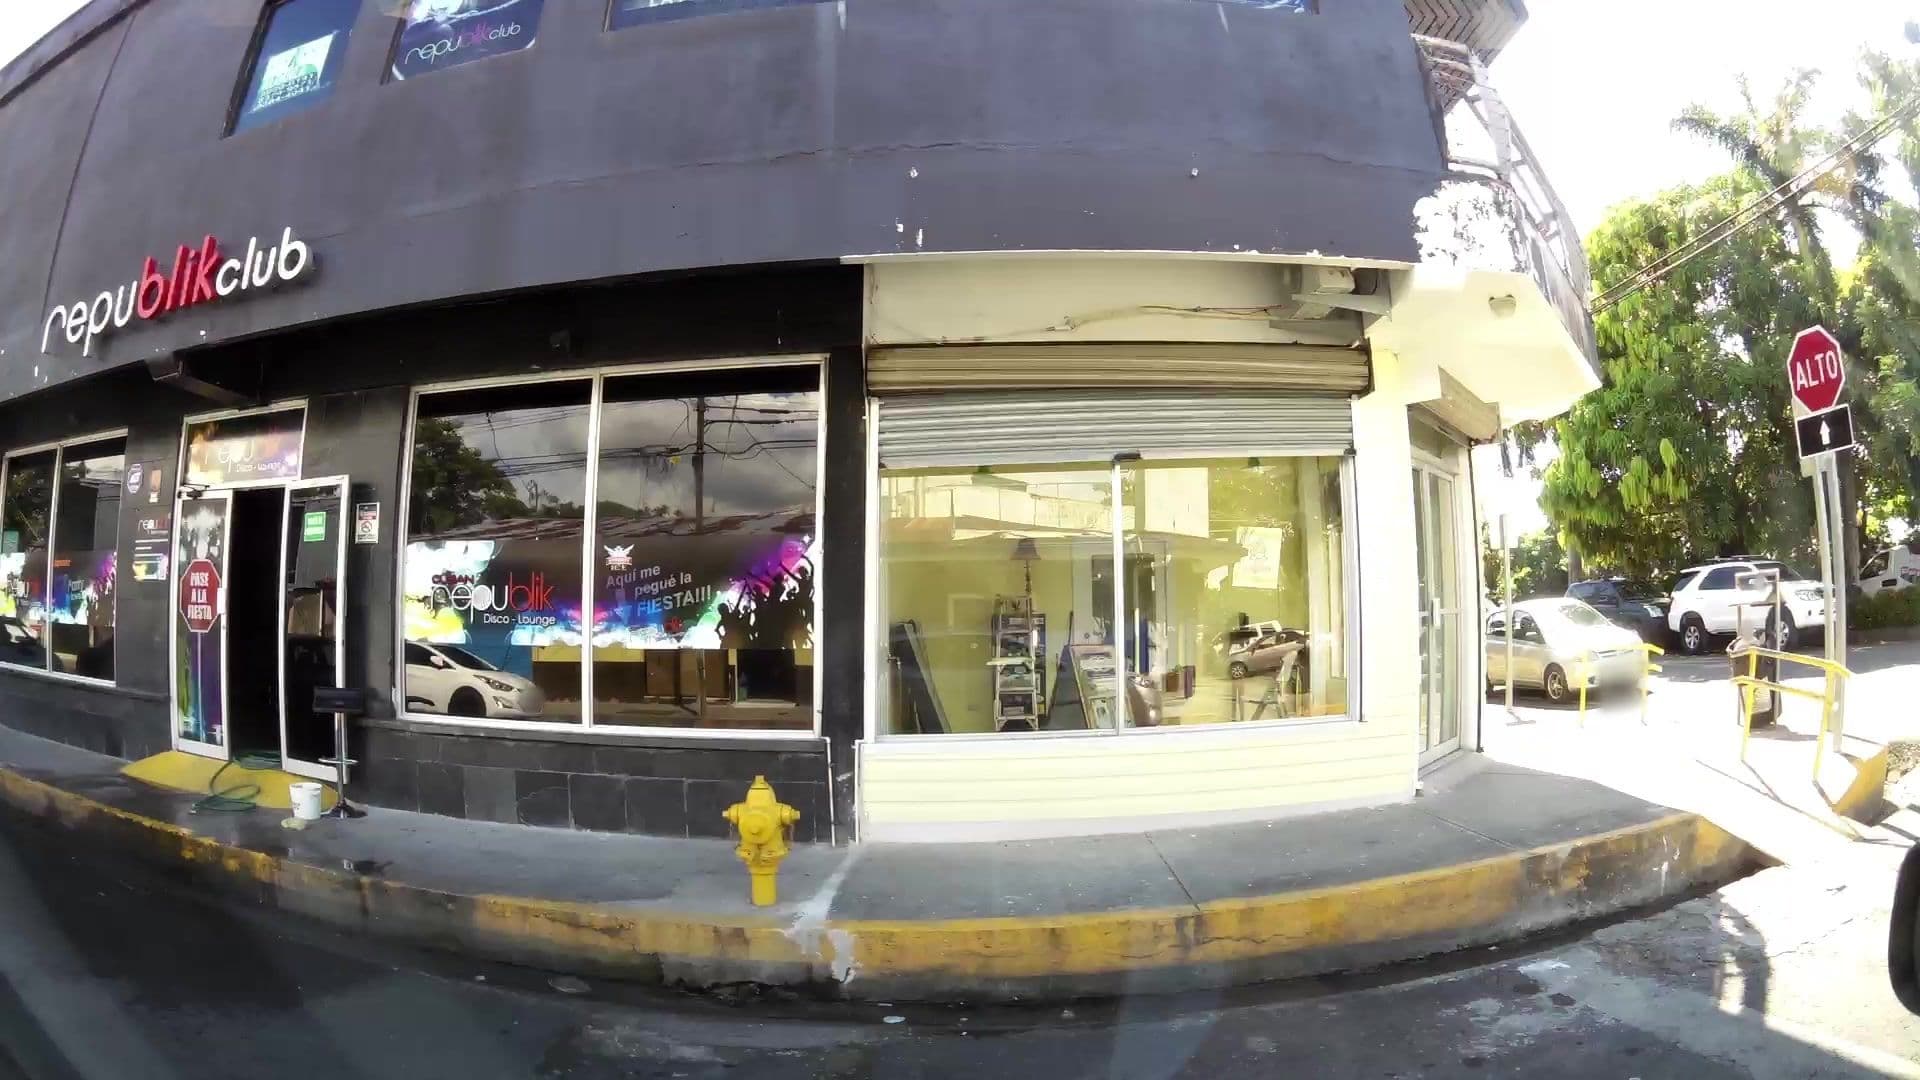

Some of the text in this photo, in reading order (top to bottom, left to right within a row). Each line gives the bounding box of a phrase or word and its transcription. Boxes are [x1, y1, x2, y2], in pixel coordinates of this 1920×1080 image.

[41, 226, 309, 357] republikclub
[1796, 350, 1838, 391] ALTO
[190, 571, 209, 587] PASE
[606, 566, 661, 588] Aquí me
[635, 572, 692, 600] pegué la
[191, 588, 197, 603] A
[431, 571, 555, 624] republik
[188, 604, 212, 620] FIESTA
[483, 613, 510, 624] Disco
[517, 613, 556, 626] Lounge
